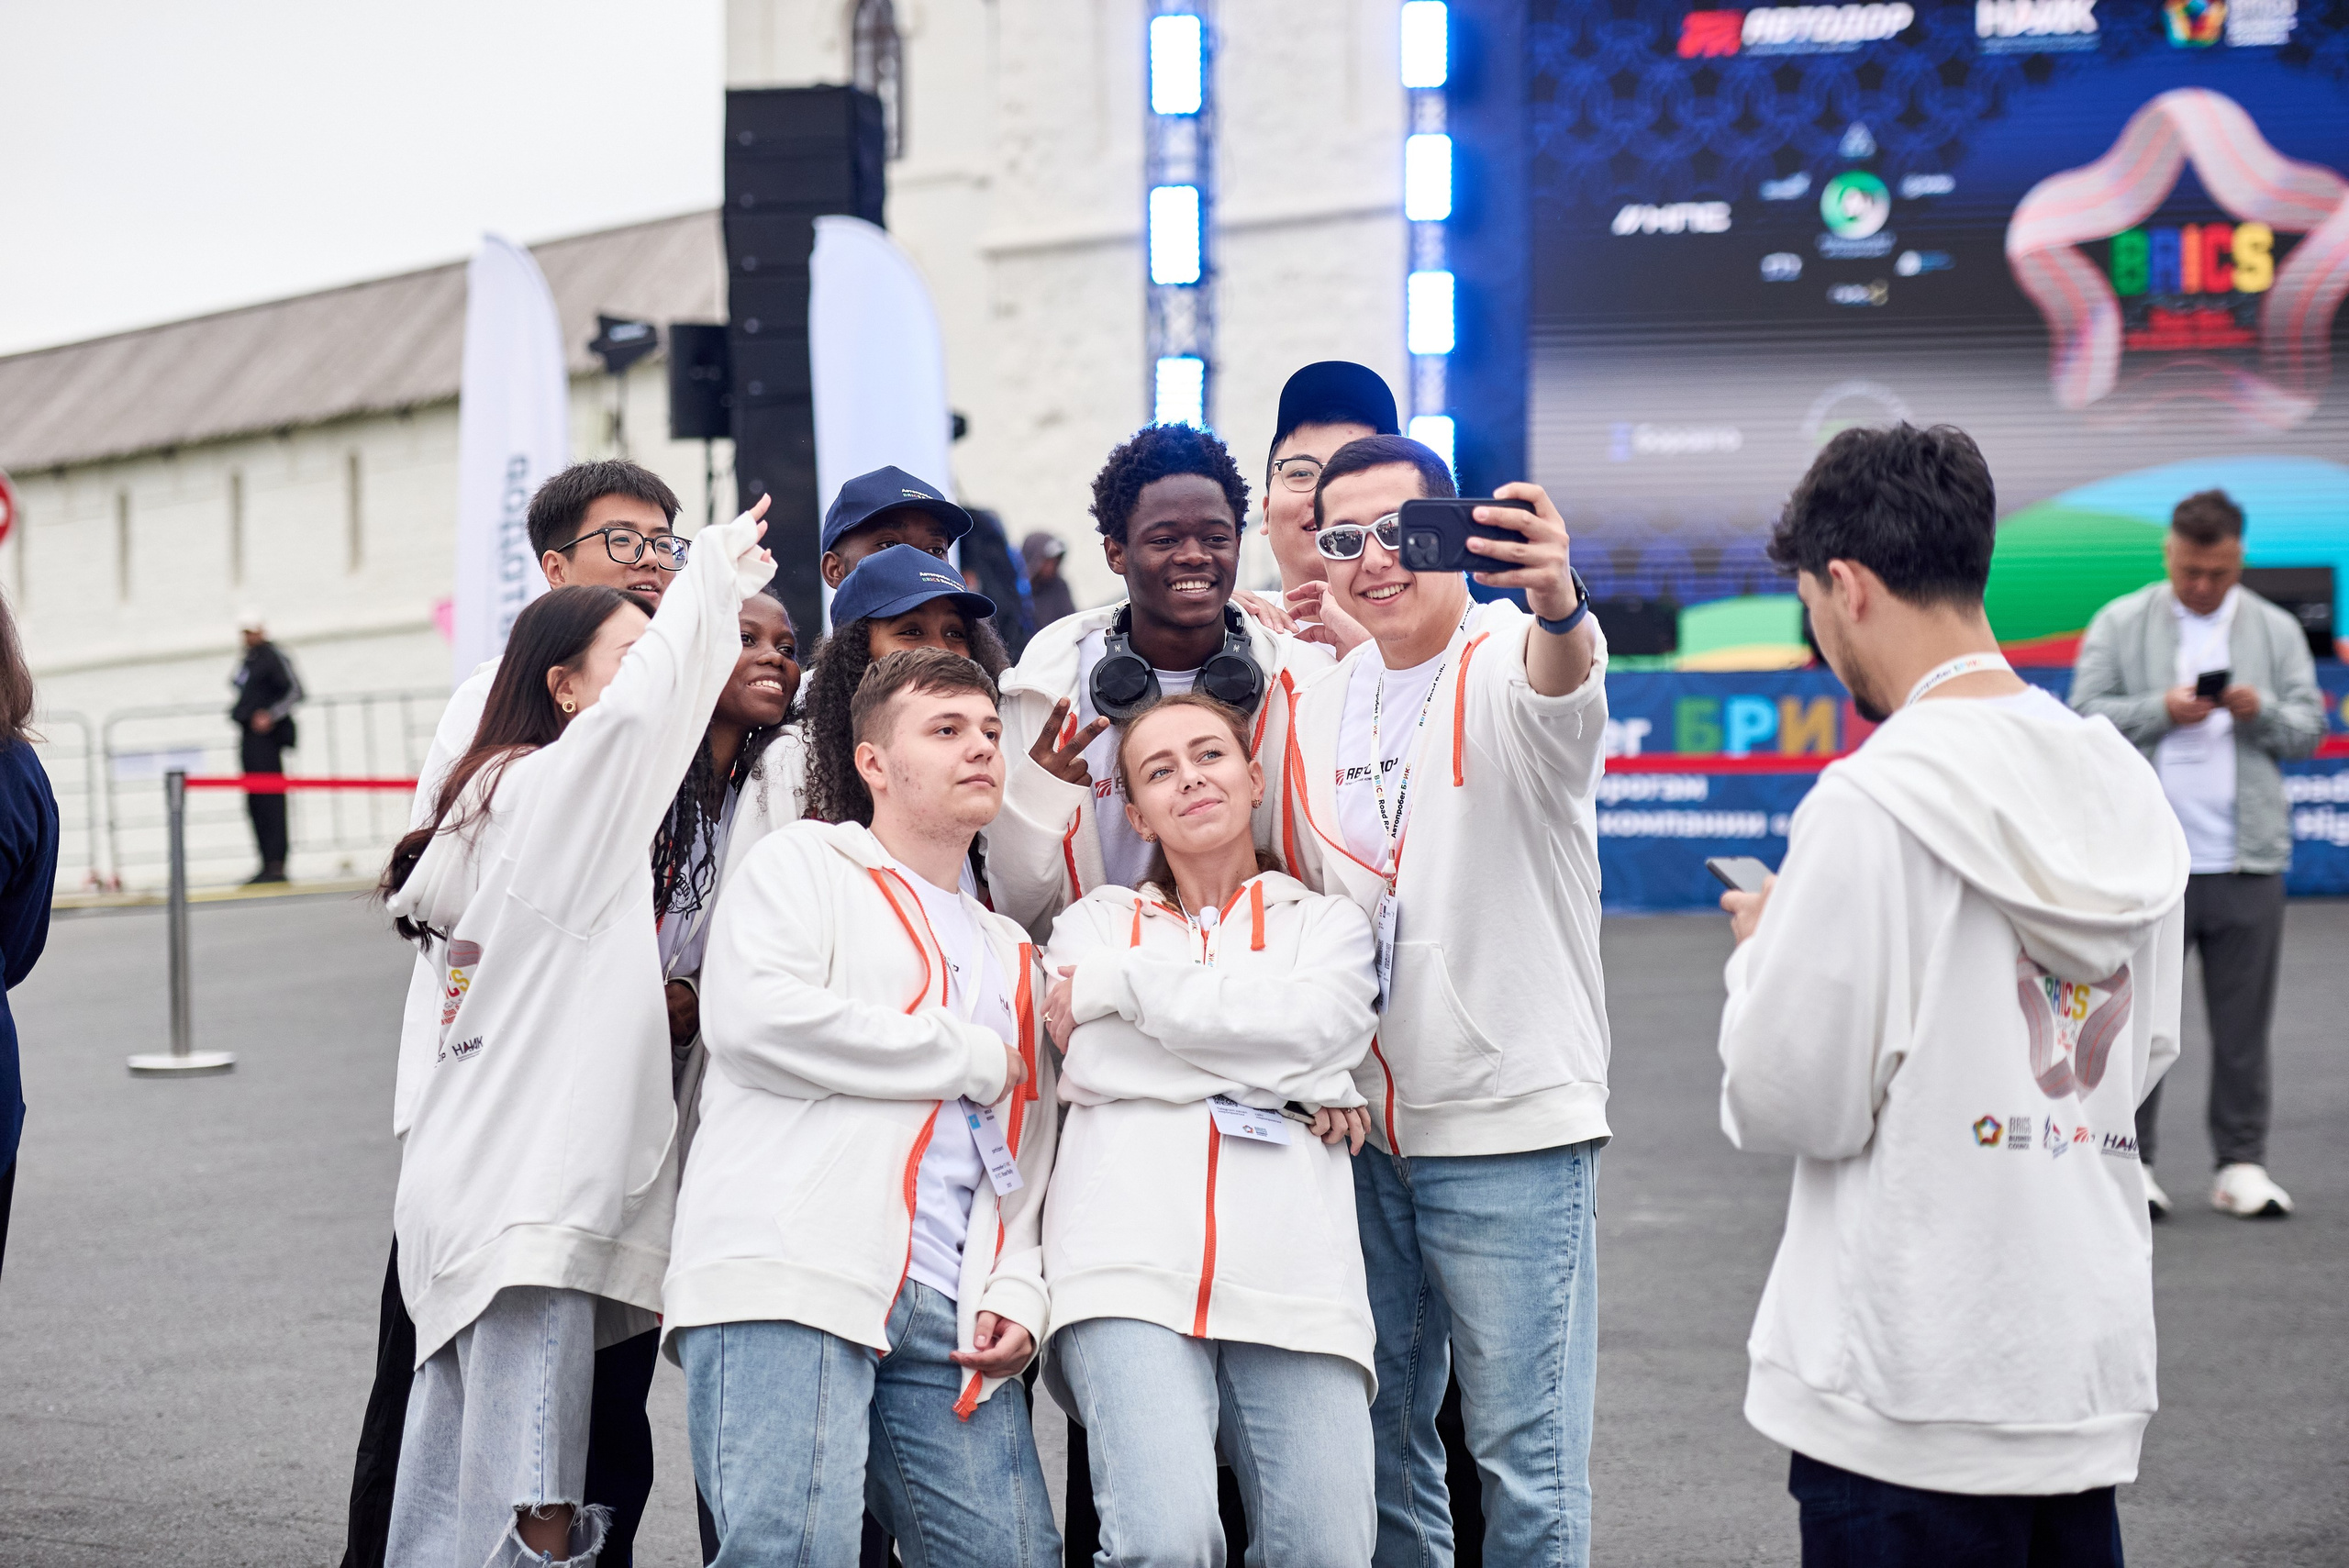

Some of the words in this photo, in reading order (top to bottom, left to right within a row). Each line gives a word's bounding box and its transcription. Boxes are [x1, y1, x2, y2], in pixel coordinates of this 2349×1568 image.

[2110, 221, 2275, 297] BRICS
[1419, 703, 1430, 728] BRICS
[1427, 683, 1437, 703] Road
[1374, 774, 1384, 798] BRICS
[1391, 791, 1406, 839] Автопробег
[1400, 762, 1411, 790] БРИКС
[1378, 799, 1388, 819] Road
